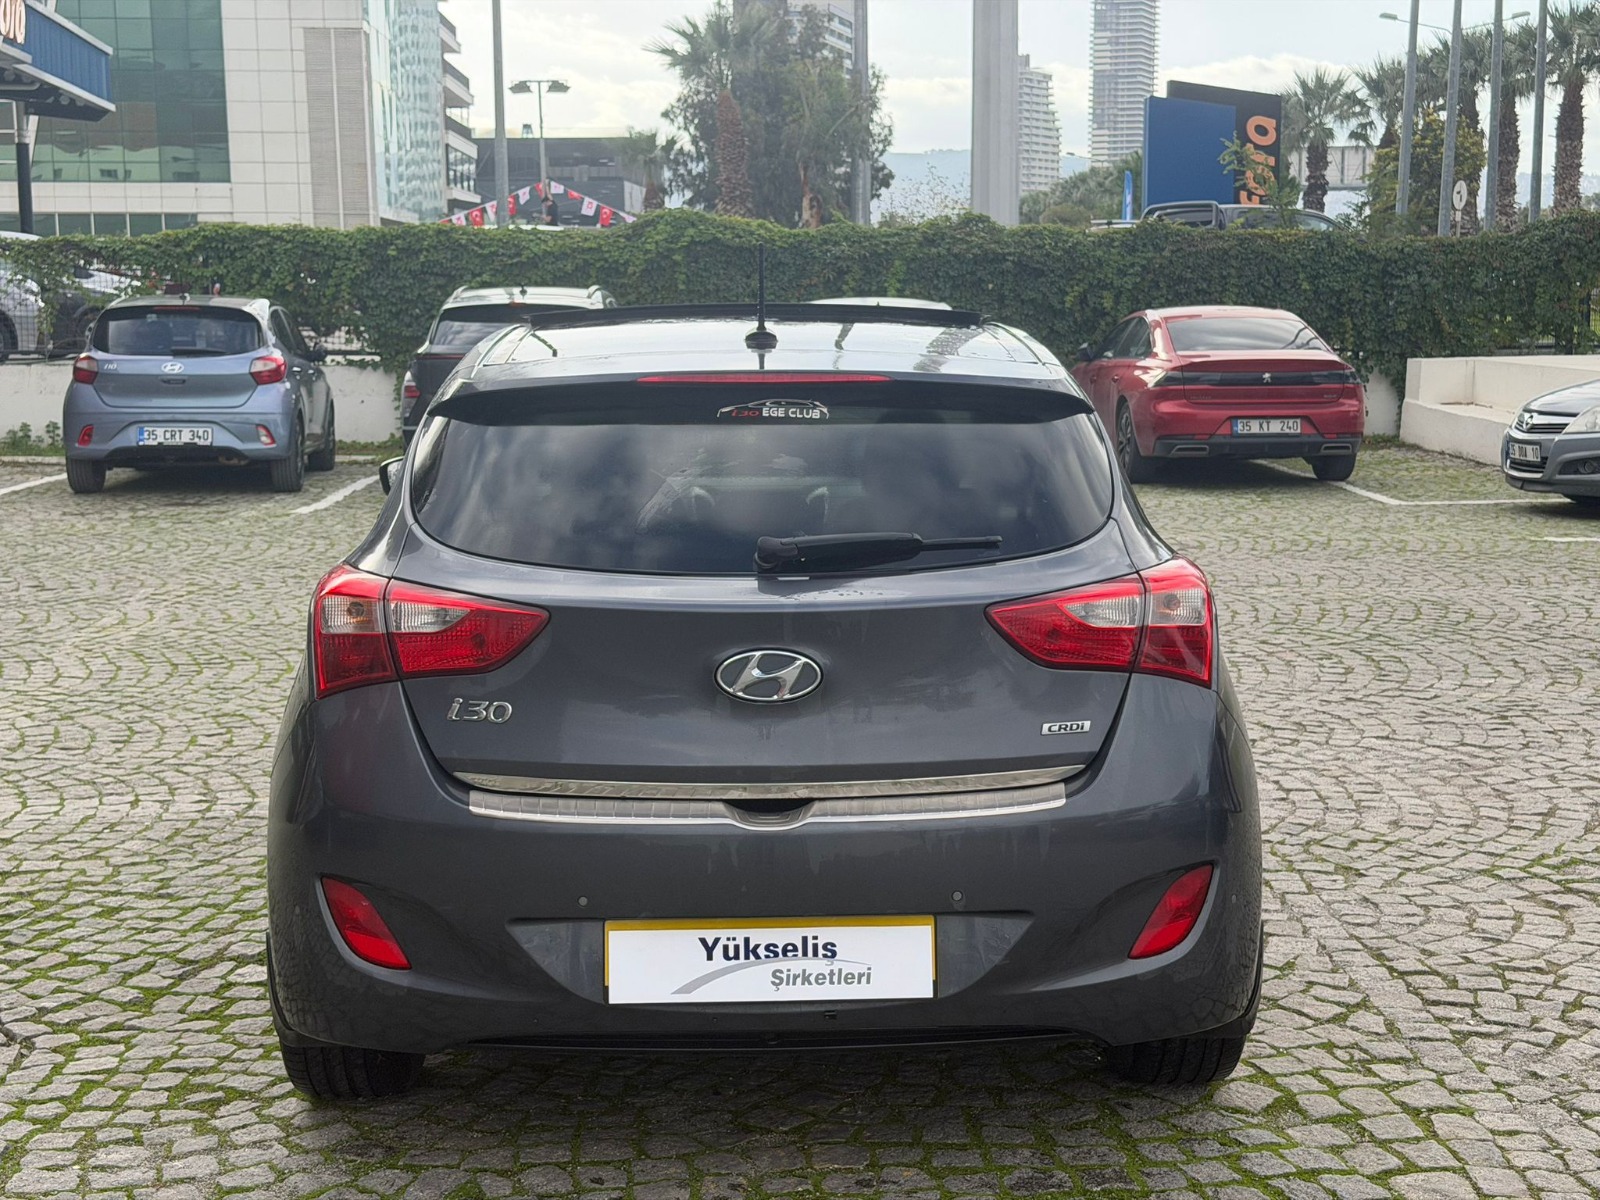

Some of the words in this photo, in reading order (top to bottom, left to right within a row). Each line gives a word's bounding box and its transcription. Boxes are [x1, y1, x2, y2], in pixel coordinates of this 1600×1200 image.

[762, 407, 785, 417] EGE
[788, 407, 821, 419] CLUB
[1238, 420, 1252, 432] 35
[1258, 420, 1272, 432] KT
[1279, 420, 1299, 432] 240
[144, 429, 158, 441] 35
[163, 429, 184, 441] CRT
[188, 429, 209, 441] 340
[446, 697, 513, 724] i30
[1047, 722, 1085, 733] CRDi
[698, 935, 838, 966] Yükseliş
[770, 967, 872, 992] Şirketleri
